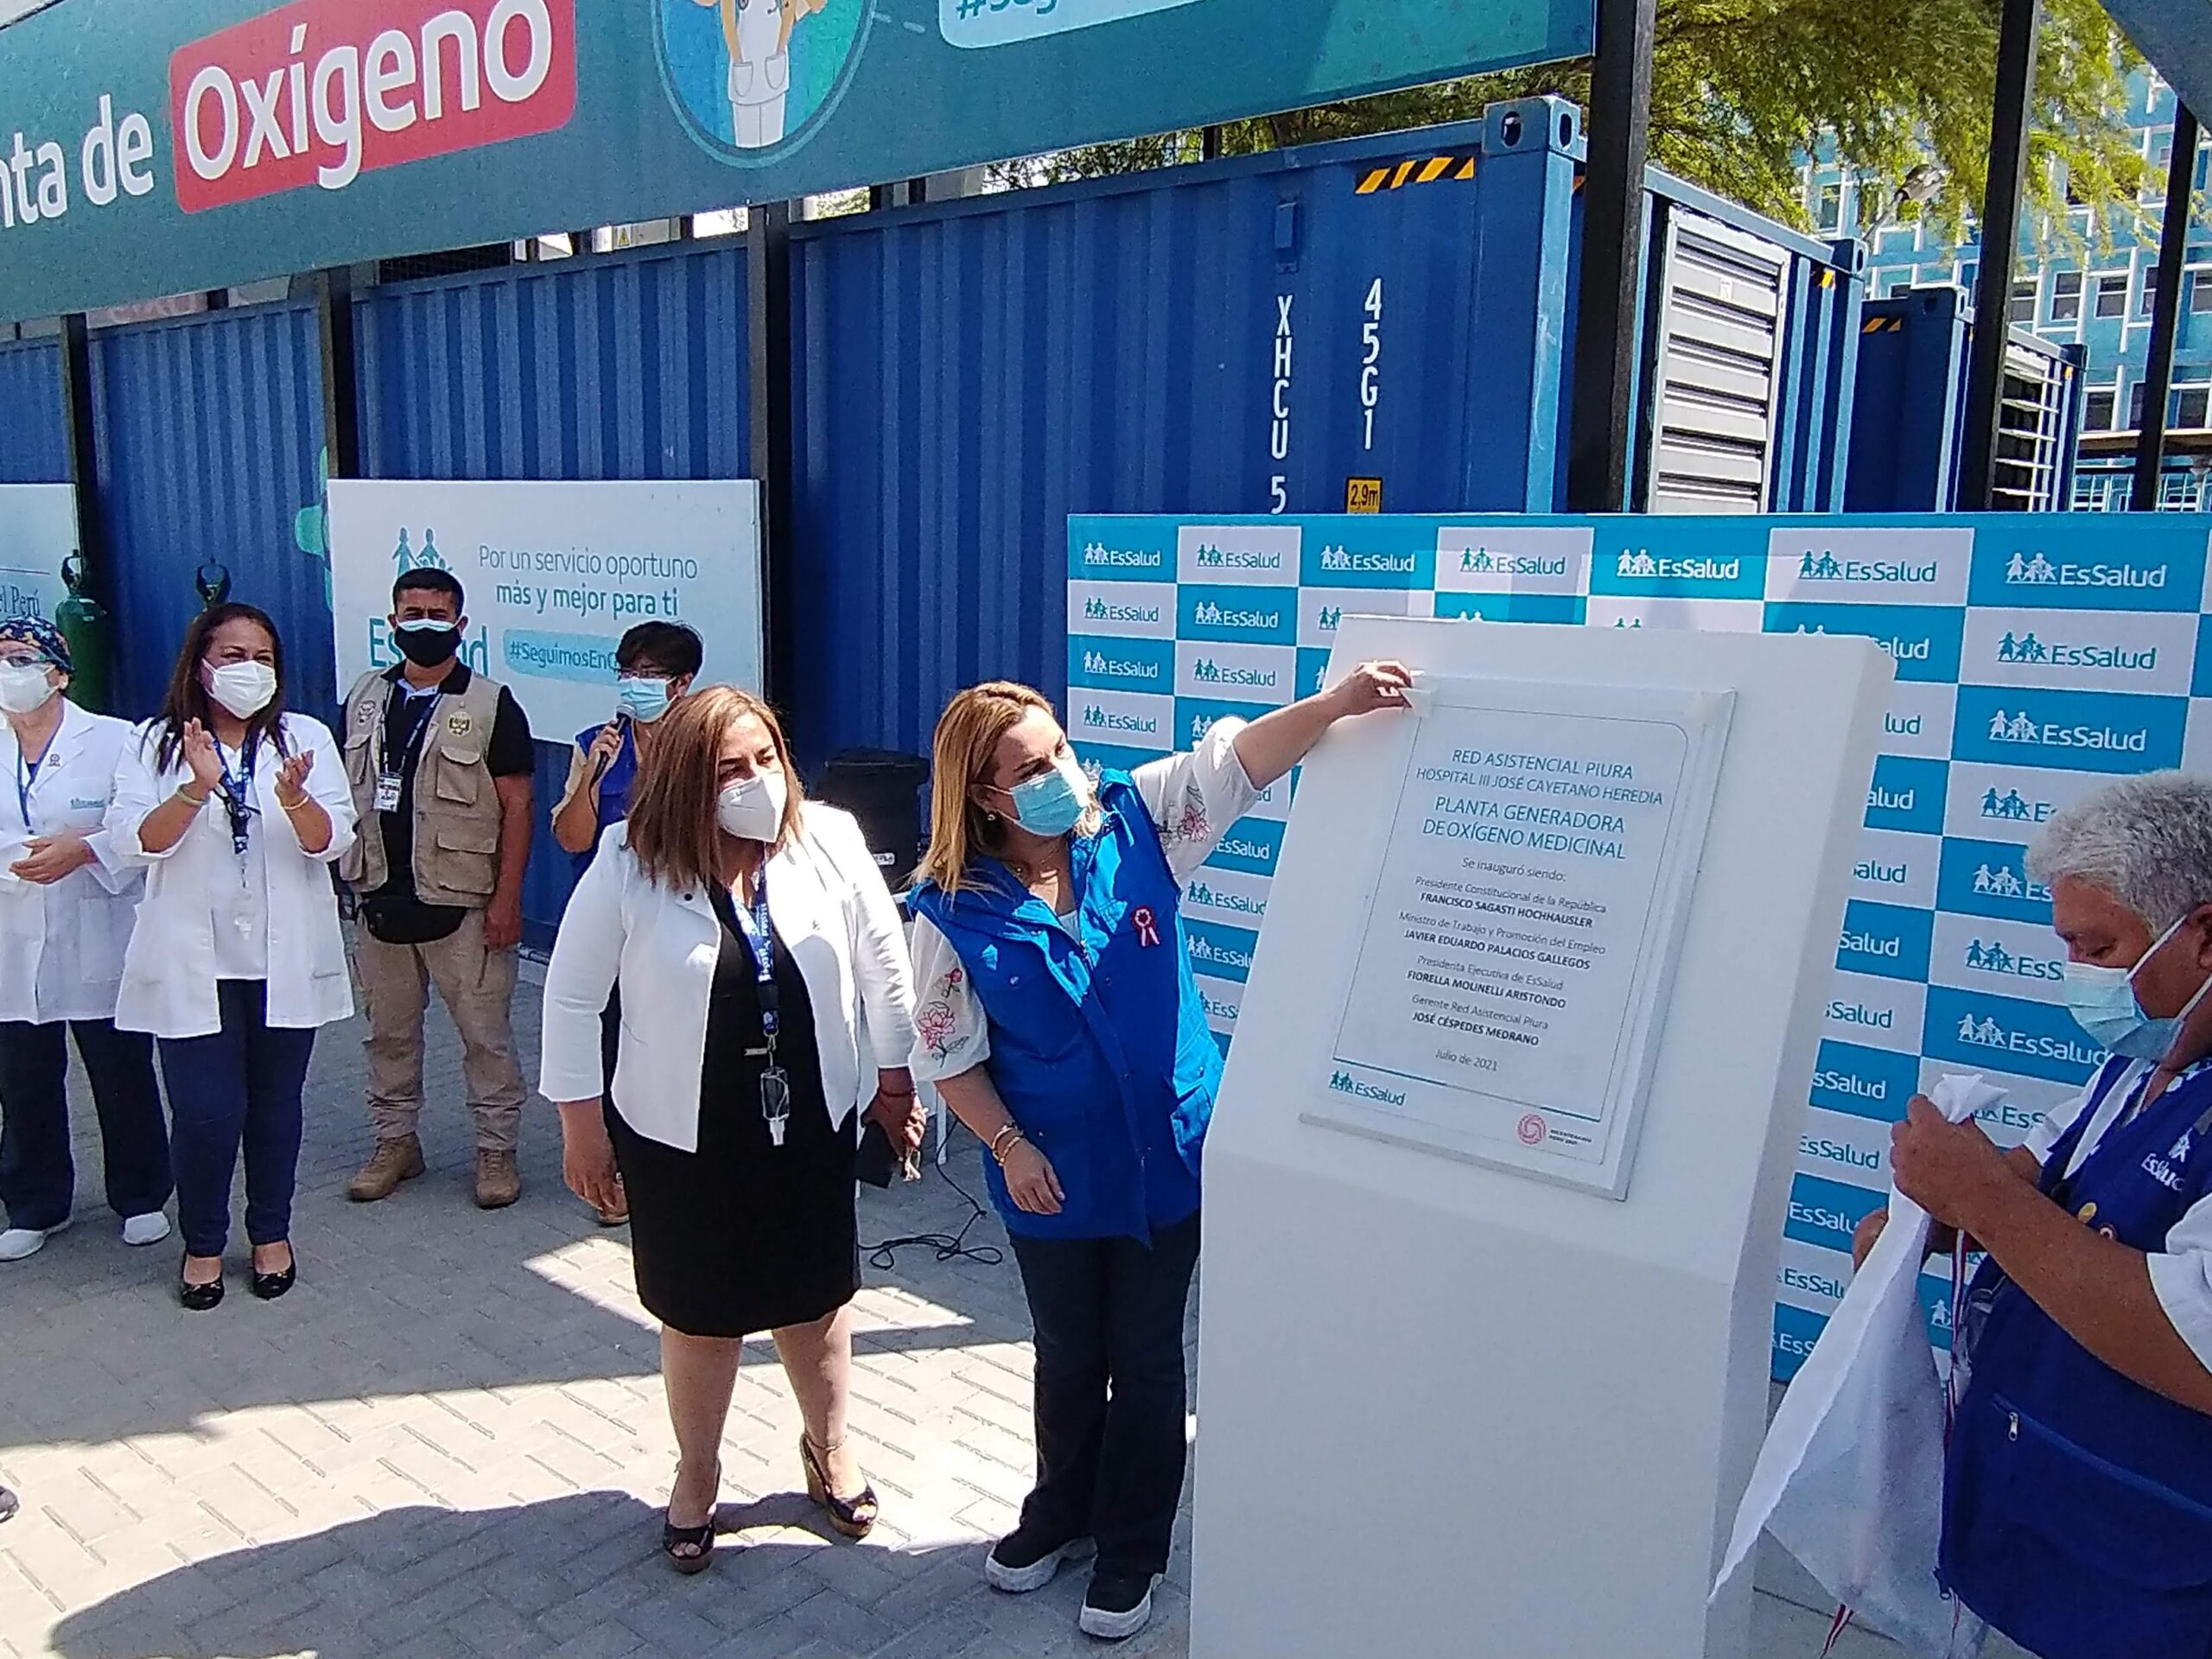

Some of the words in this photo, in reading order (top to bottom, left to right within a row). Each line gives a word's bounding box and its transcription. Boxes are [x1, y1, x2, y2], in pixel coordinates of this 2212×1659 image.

[83, 93, 154, 206] de
[185, 0, 552, 189] Oxígeno
[1361, 277, 1382, 450] 45G1
[1272, 294, 1293, 460] XHCU
[479, 545, 505, 569] Por
[511, 551, 530, 570] un
[535, 547, 601, 575] servicio
[606, 551, 698, 581] oportuno
[1110, 550, 1160, 566] EsSalud
[1225, 552, 1280, 569] EsSalud
[1352, 553, 1414, 572] EsSalud
[1497, 556, 1565, 575] EsSalud
[1658, 557, 1739, 580] EsSalud
[1845, 561, 1937, 582] EsSalud
[2059, 563, 2166, 588] EsSalud
[497, 580, 530, 605] más
[536, 588, 547, 614] y
[554, 588, 606, 617] mejor
[613, 594, 655, 620] para
[662, 588, 678, 616] ti
[1109, 607, 1158, 622] EsSalud
[1224, 612, 1278, 628] EsSalud
[1109, 661, 1158, 678] EsSalud
[2052, 645, 2157, 671] EsSalud
[1221, 670, 1275, 686] EsSalud
[1108, 715, 1156, 733] EsSalud
[2042, 724, 2147, 753] EsSalud
[1452, 749, 1481, 764] RED
[1484, 753, 1580, 775] ASISTENCIAL
[1586, 762, 1633, 779] PIURA
[1417, 768, 1475, 785] HOSPITAL
[1478, 773, 1490, 786] III
[1492, 775, 1523, 790] JOSÉ
[1527, 779, 1599, 798] CAYETANO
[1602, 788, 1663, 804] HEREDIA
[1435, 797, 1498, 818] PLANTA
[1503, 804, 1624, 833] GENERADORA
[1527, 832, 1626, 859] MEDICINAL
[1461, 858, 1475, 868] Se
[1477, 861, 1524, 876] inauguró
[1526, 868, 1567, 882] siendo:
[1415, 876, 1463, 892] Presidente
[1465, 884, 1531, 902] Constitucional
[1532, 893, 1546, 904] de
[1548, 896, 1556, 906] la
[1558, 898, 1606, 913] República
[1421, 893, 1473, 908] FRANCISCO
[1474, 901, 1516, 916] SAGASTI
[1399, 912, 1435, 925] Ministro
[1438, 916, 1450, 928] de
[1452, 919, 1486, 935] Trabajo
[1488, 927, 1495, 937] y
[1497, 927, 1548, 945] Promoción
[1550, 937, 1565, 948] del
[1567, 939, 1605, 955] Empleo
[1213, 948, 1253, 969] EsSal
[1404, 930, 1436, 943] JAVIER
[1438, 935, 1485, 951] EDUARDO
[1487, 944, 1535, 960] PALACIOS
[1537, 953, 1591, 969] GALLEGOS
[1418, 956, 1465, 972] Presidenta
[1468, 964, 1509, 981] Ejecutiva
[1511, 973, 1523, 983] de
[1526, 976, 1563, 990] EsSalud
[1408, 970, 1450, 987] FIORELLA
[1452, 979, 1503, 997] MOLINELLI
[1505, 989, 1567, 1009] ARISTONDO
[1412, 995, 1450, 1010] Gerente
[1452, 1002, 1469, 1014] Red
[1471, 1006, 1521, 1024] Asistencial
[1523, 1016, 1548, 1029] Piura
[1825, 1001, 1893, 1028] Salud
[1412, 1011, 1435, 1024] JOSÉ
[1437, 1016, 1484, 1034] CÉSPEDES
[1485, 1027, 1539, 1046] MEDRANO
[1435, 1049, 1457, 1062] Julio
[1459, 1054, 1471, 1065] de
[1473, 1057, 1497, 1071] 2021
[1355, 1082, 1406, 1107] EsSalud
